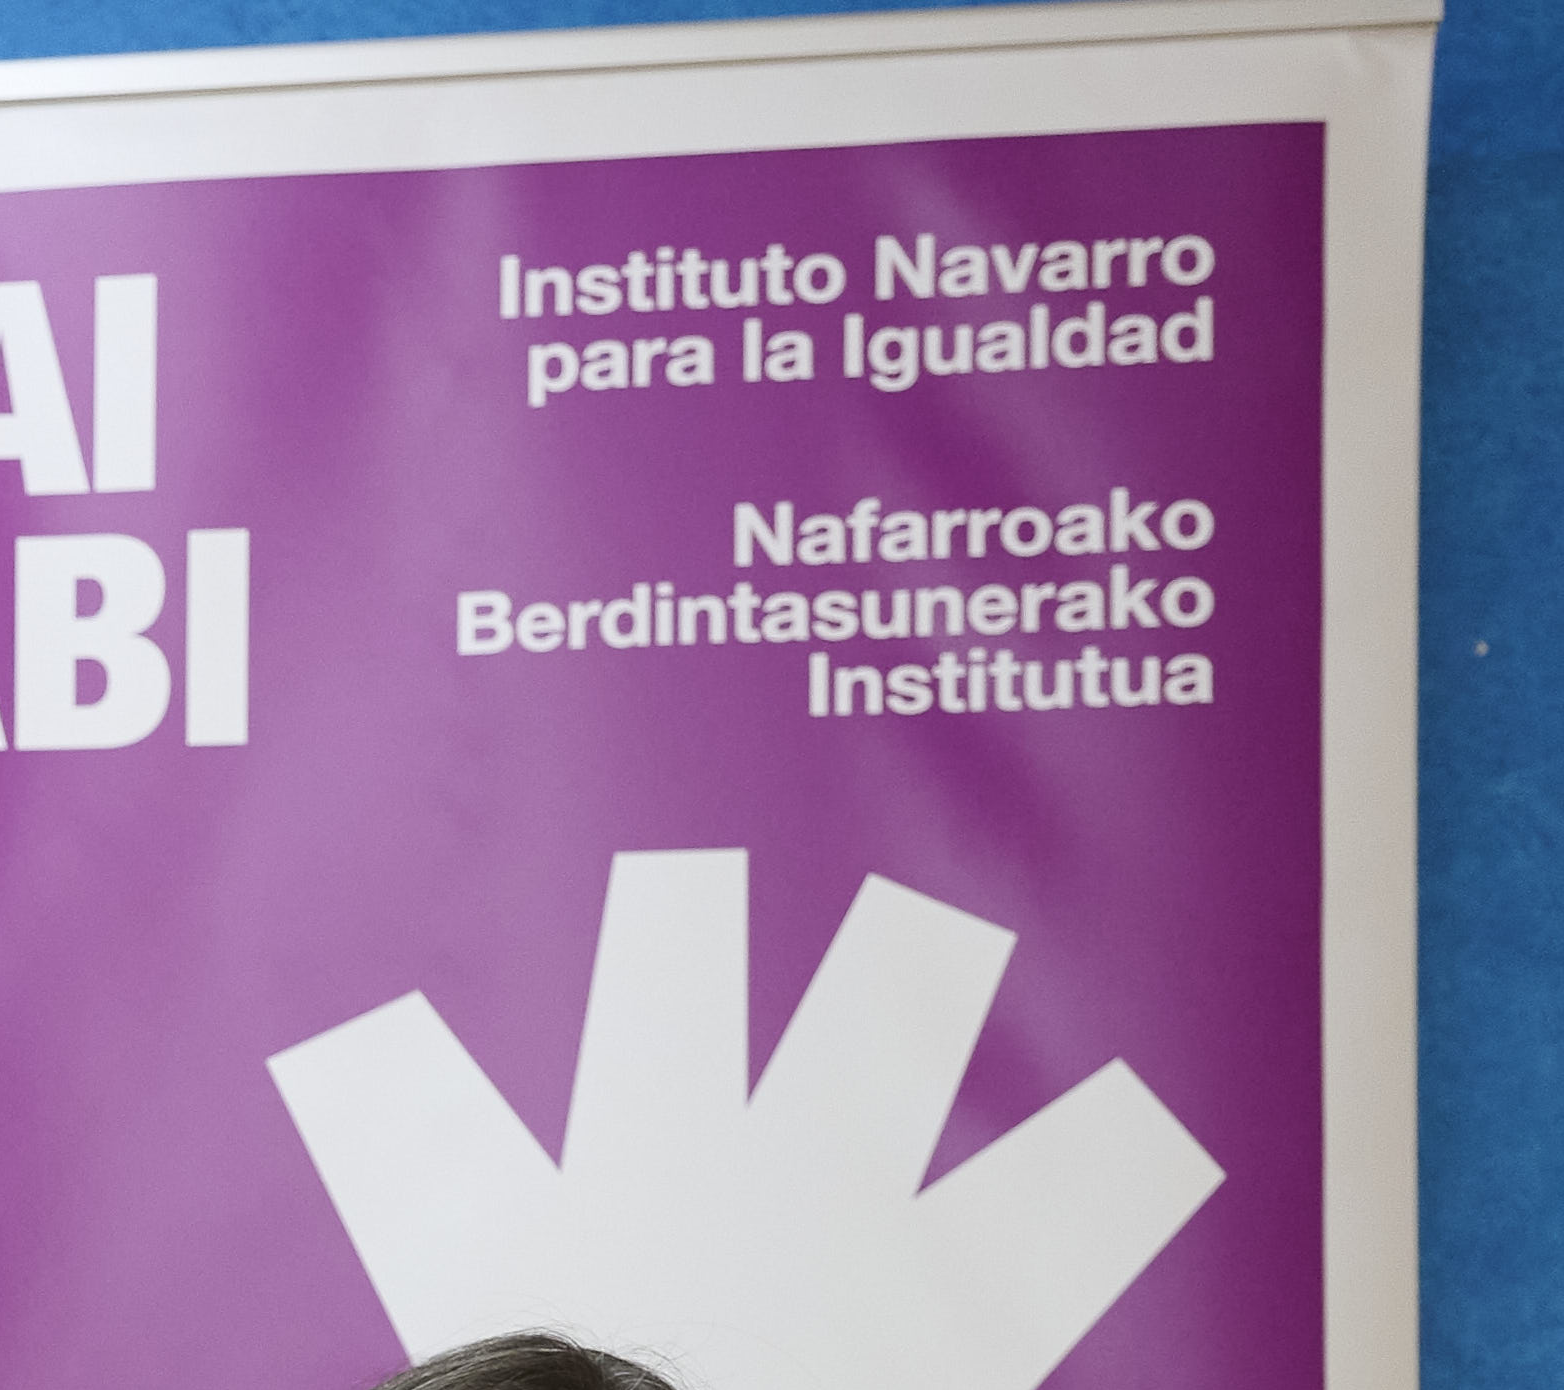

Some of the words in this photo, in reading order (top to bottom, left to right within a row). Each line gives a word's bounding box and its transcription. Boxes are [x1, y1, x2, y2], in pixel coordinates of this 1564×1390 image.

[497, 252, 847, 322] Instituto
[874, 232, 1217, 301] Navarro
[526, 334, 716, 409] para
[742, 316, 815, 383] la
[843, 295, 1215, 393] Igualdad
[733, 486, 1216, 568] Nafarroako
[455, 562, 1216, 658] Berdintasunerako
[808, 643, 1215, 719] Institutua
